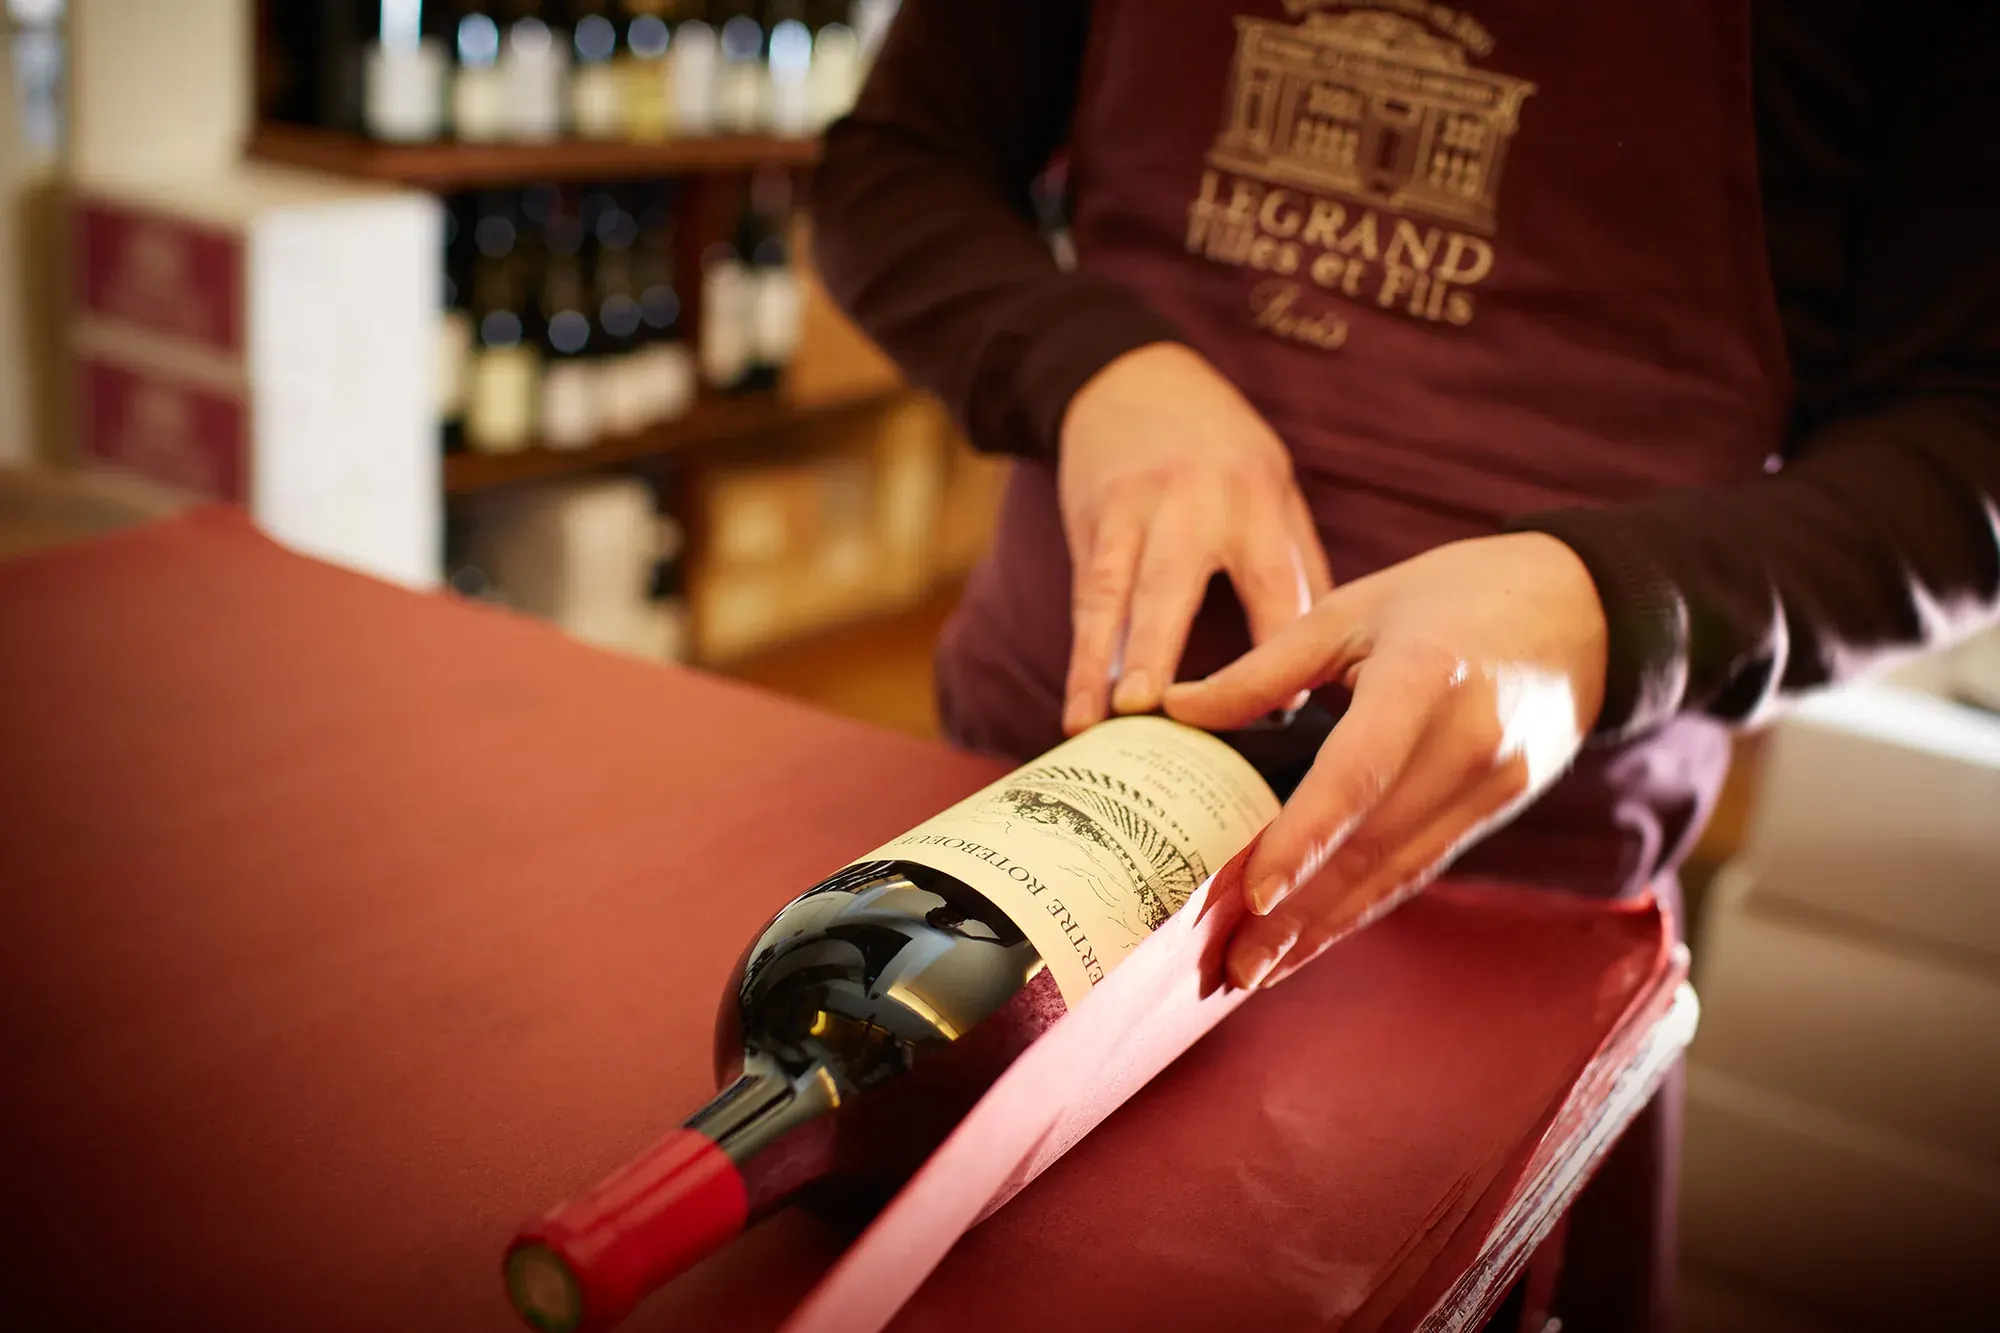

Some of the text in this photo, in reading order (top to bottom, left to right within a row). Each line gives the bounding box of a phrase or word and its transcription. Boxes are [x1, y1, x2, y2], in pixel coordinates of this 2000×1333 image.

[1198, 169, 1494, 285] LEGRAND
[1309, 252, 1367, 297] et
[1045, 898, 1105, 988] ERTRE
